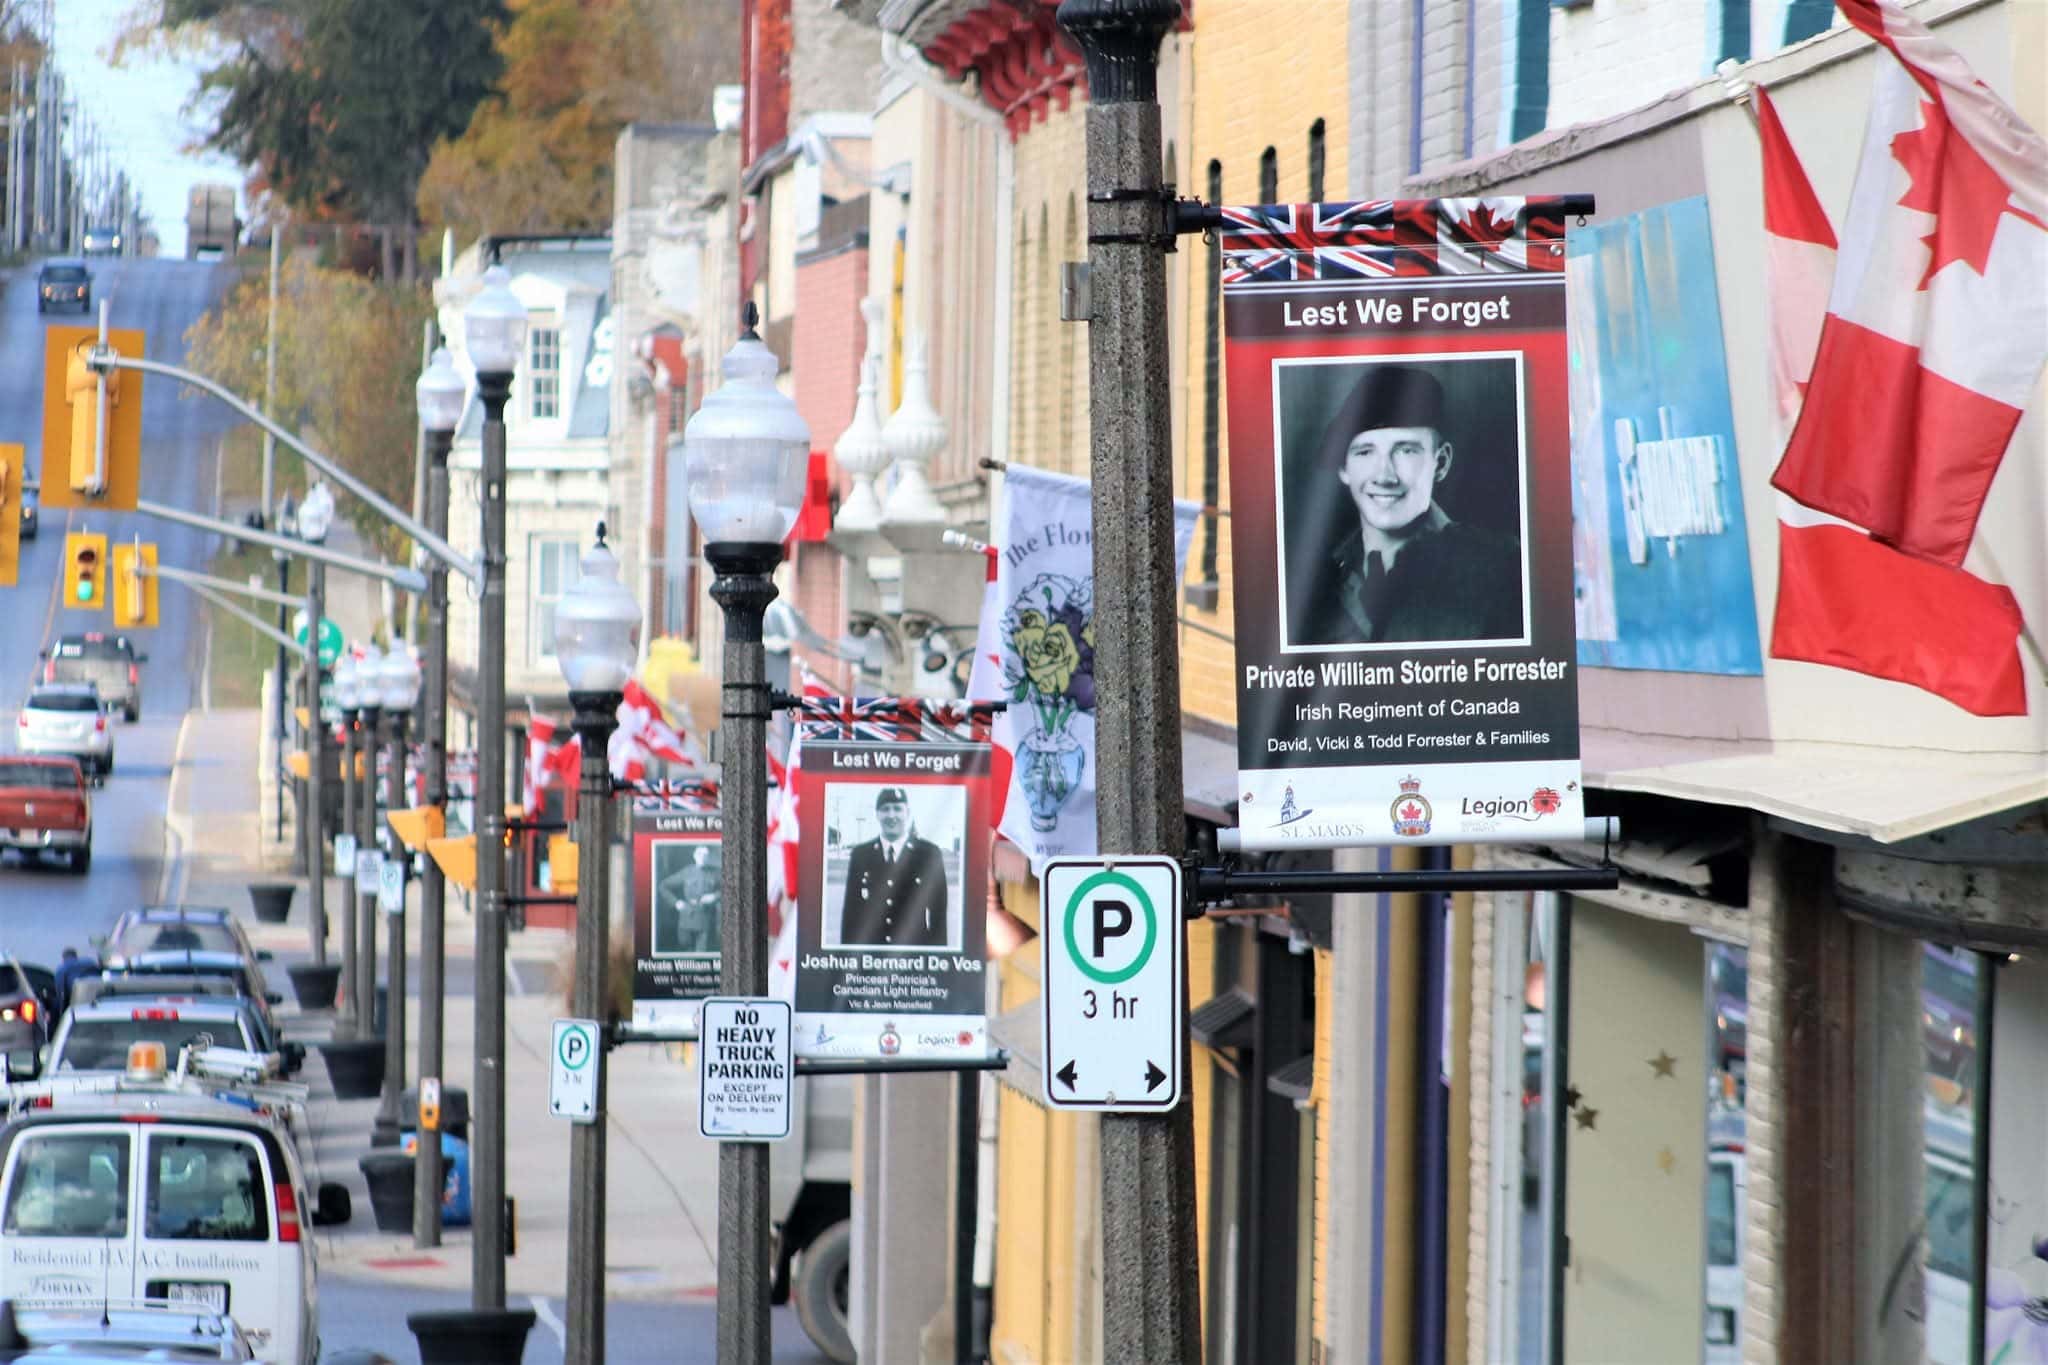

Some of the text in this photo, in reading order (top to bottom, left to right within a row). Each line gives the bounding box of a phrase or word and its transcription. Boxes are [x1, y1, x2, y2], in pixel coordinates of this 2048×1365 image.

[1282, 294, 1511, 328] Lest We Forget
[1245, 657, 1568, 689] Private William Storrie Forrester
[1294, 697, 1520, 723] Irish Regiment of Canada
[1267, 730, 1550, 753] David, Vicki & Todd Forrester & Families
[832, 750, 960, 773] Lest We Forget
[1461, 796, 1528, 818] Legion
[656, 817, 683, 830] Lest
[1093, 899, 1133, 958] P
[800, 954, 982, 972] Joshua Bernard De Vos
[845, 973, 937, 986] Princess Patricia's
[832, 985, 948, 999] Canadian Light Infantry
[1083, 990, 1139, 1019] 3 hr
[735, 1010, 759, 1025] NO
[717, 1027, 776, 1043] HEAVY
[568, 1037, 582, 1060] P
[717, 1045, 776, 1061] TRUCK
[708, 1063, 784, 1079] PARKING
[723, 1083, 767, 1092] EXCEPT
[708, 1094, 783, 1103] ON DELIVERY
